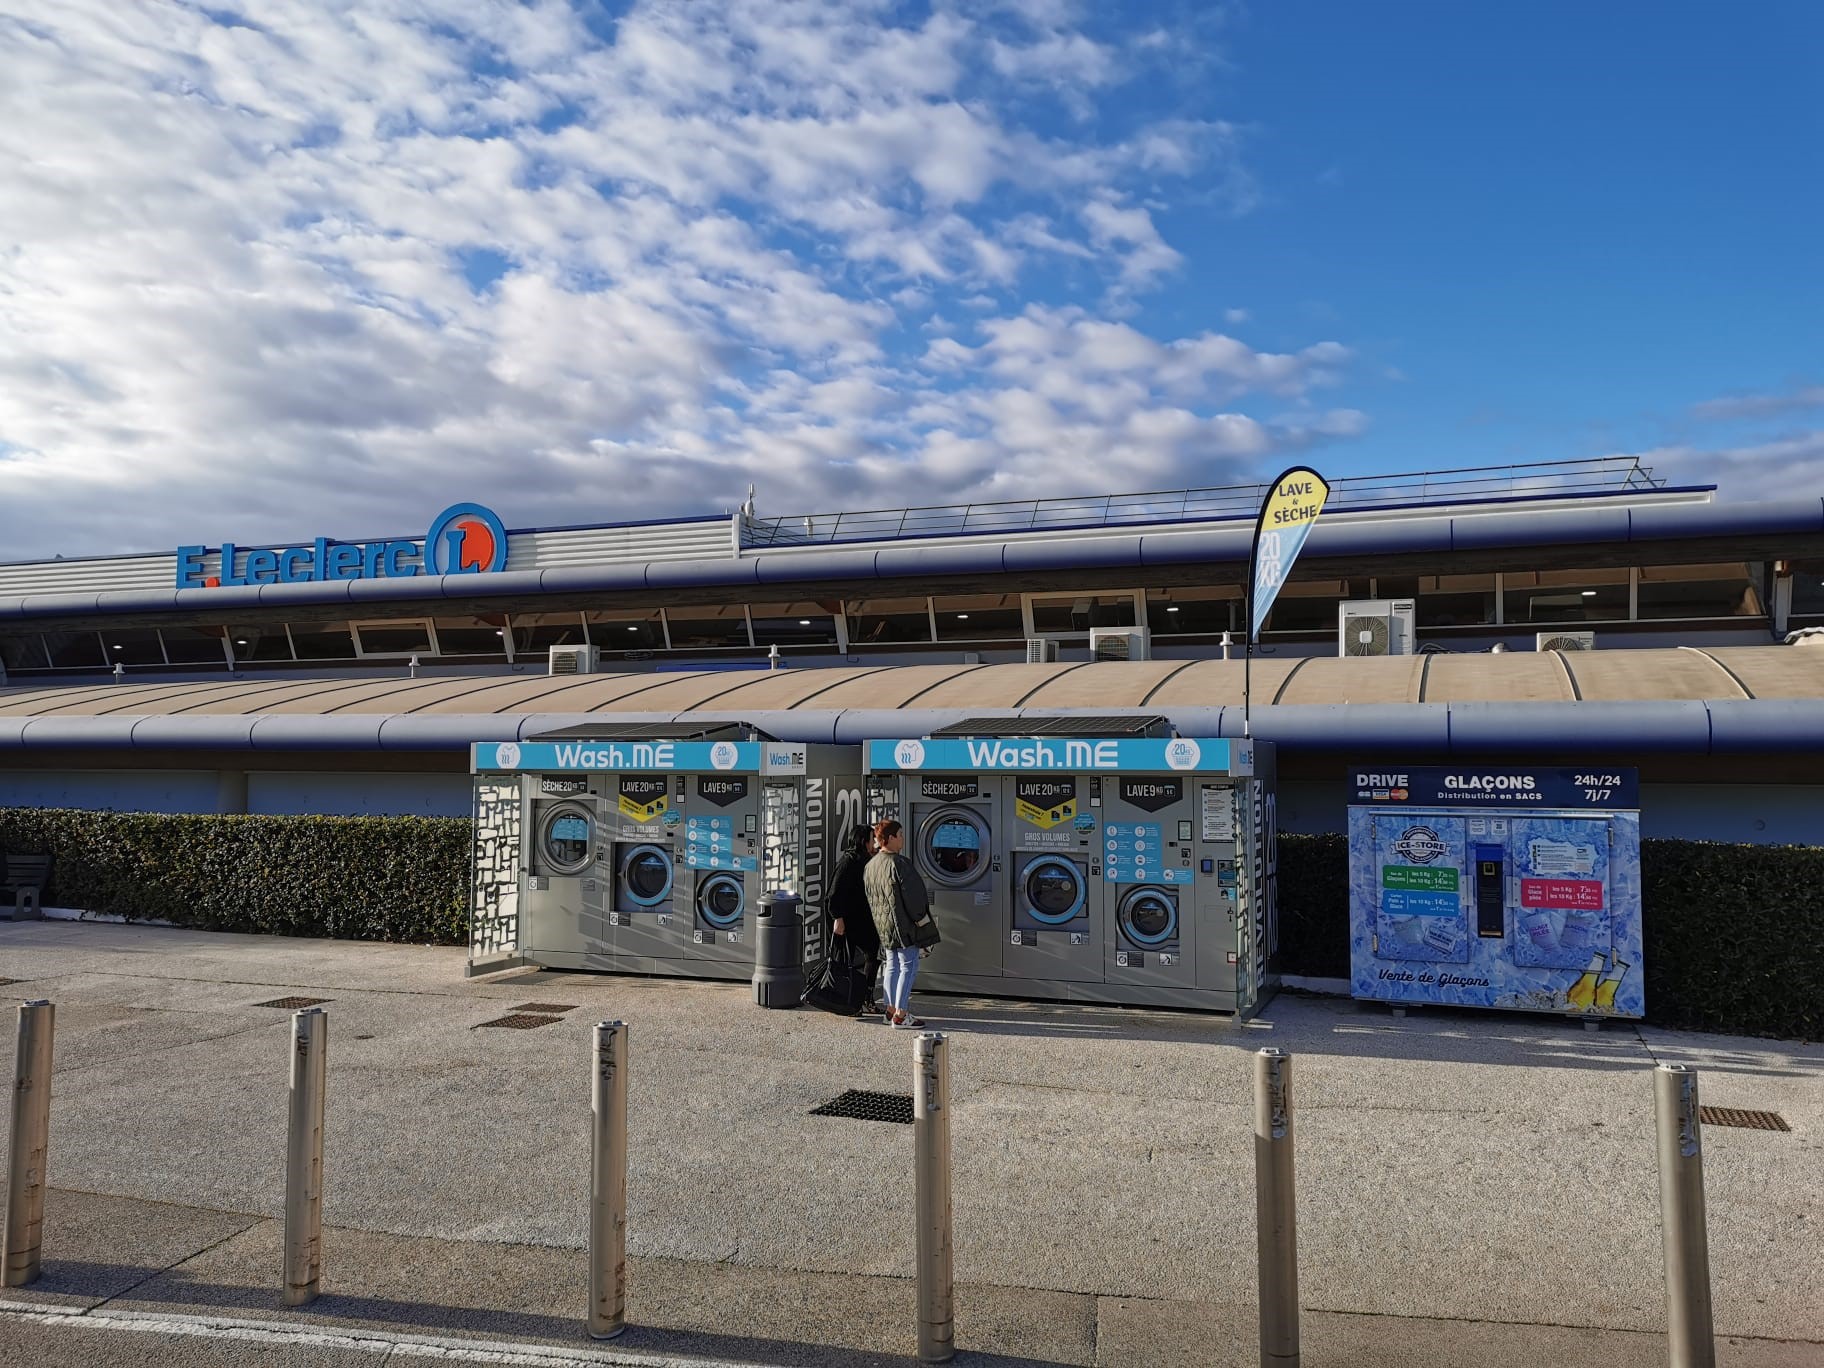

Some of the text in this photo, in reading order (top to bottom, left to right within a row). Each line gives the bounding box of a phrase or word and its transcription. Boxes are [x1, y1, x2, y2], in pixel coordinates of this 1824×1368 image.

[1279, 482, 1313, 497] LAVE
[1292, 497, 1299, 505] &
[1274, 504, 1317, 524] SÈCHE
[1259, 531, 1281, 561] 20
[176, 537, 419, 589] E.Leclerc
[967, 741, 1119, 768] Wash.ME
[1174, 743, 1185, 755] 20
[554, 744, 675, 768] Wash.ME
[769, 752, 804, 766] Wash.ME
[564, 781, 573, 792] 20
[622, 781, 639, 792] LAVE
[640, 781, 649, 792] 20
[1356, 774, 1409, 787] DRIVE
[1444, 775, 1536, 793] GLAÇONS
[1574, 775, 1621, 786] 24h/24
[703, 782, 721, 793] LAVE
[721, 782, 727, 793] 9
[922, 780, 948, 795] SÈCHE
[948, 783, 959, 795] 20
[1020, 783, 1041, 796] LAVE
[1042, 783, 1052, 796] 20
[1127, 784, 1149, 797] LAVE
[1150, 784, 1156, 797] 9
[1437, 792, 1497, 800] Distribution
[1584, 789, 1611, 802] 7j/7
[1024, 832, 1071, 842] GROS VOLUMES
[1397, 841, 1446, 851] ICE-STORE
[805, 778, 823, 963] REVOLUTION
[1378, 968, 1490, 987] Vente de Glaçons
